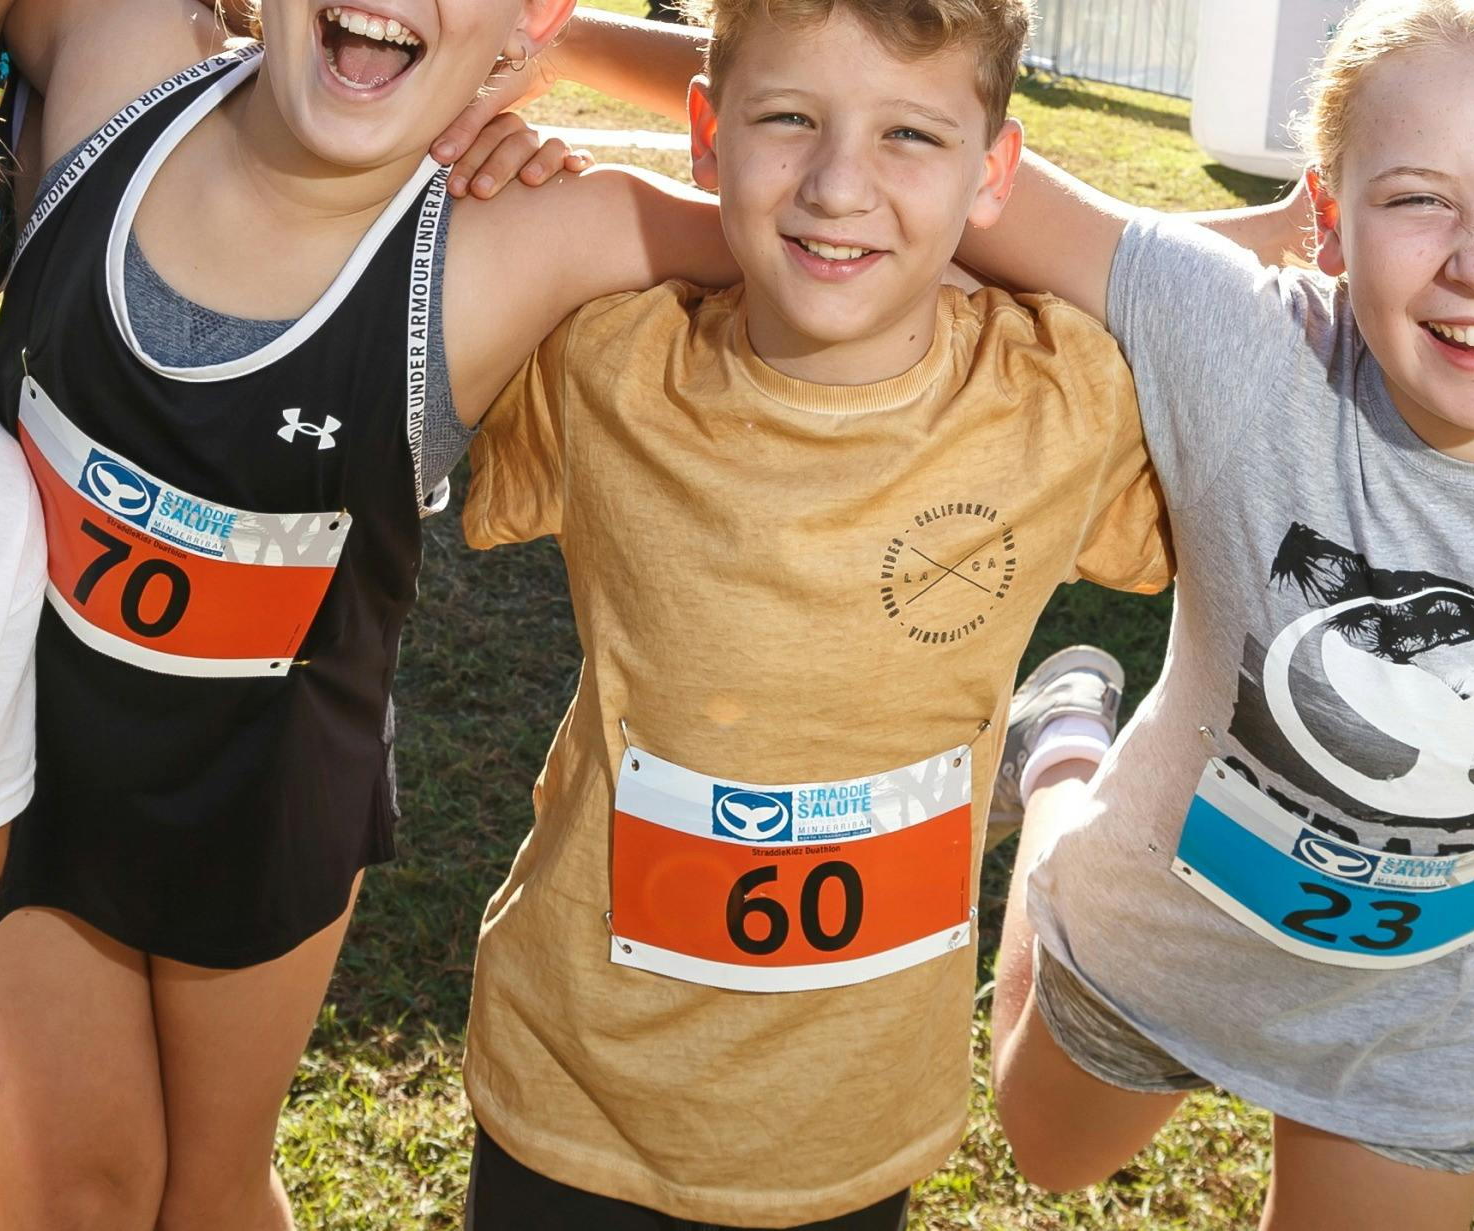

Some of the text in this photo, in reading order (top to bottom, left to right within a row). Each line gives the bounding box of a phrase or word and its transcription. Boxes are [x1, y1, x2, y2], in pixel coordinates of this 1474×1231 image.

[142, 61, 211, 107] ARMOUR
[88, 104, 140, 158] UNDER
[33, 158, 86, 221] ARMOUR
[428, 164, 451, 198] ARM
[416, 200, 440, 253] UNDER
[410, 259, 430, 340] ARMOUR
[410, 345, 425, 409] UNDER
[158, 501, 233, 538] SALUTE
[164, 491, 237, 525] STRADDIE
[914, 503, 998, 527] CALIFORNIA
[154, 520, 226, 550] MINJERRIBAH
[73, 518, 191, 638] 70
[908, 614, 985, 644] CALIFORNIA
[798, 783, 871, 802] STRADDIE
[798, 796, 871, 819] SALUTE
[798, 819, 872, 834] MINJERRIBAH
[752, 845, 841, 857] StraddieKidz Duathlon
[726, 860, 864, 955] 60
[1282, 881, 1422, 950] 23
